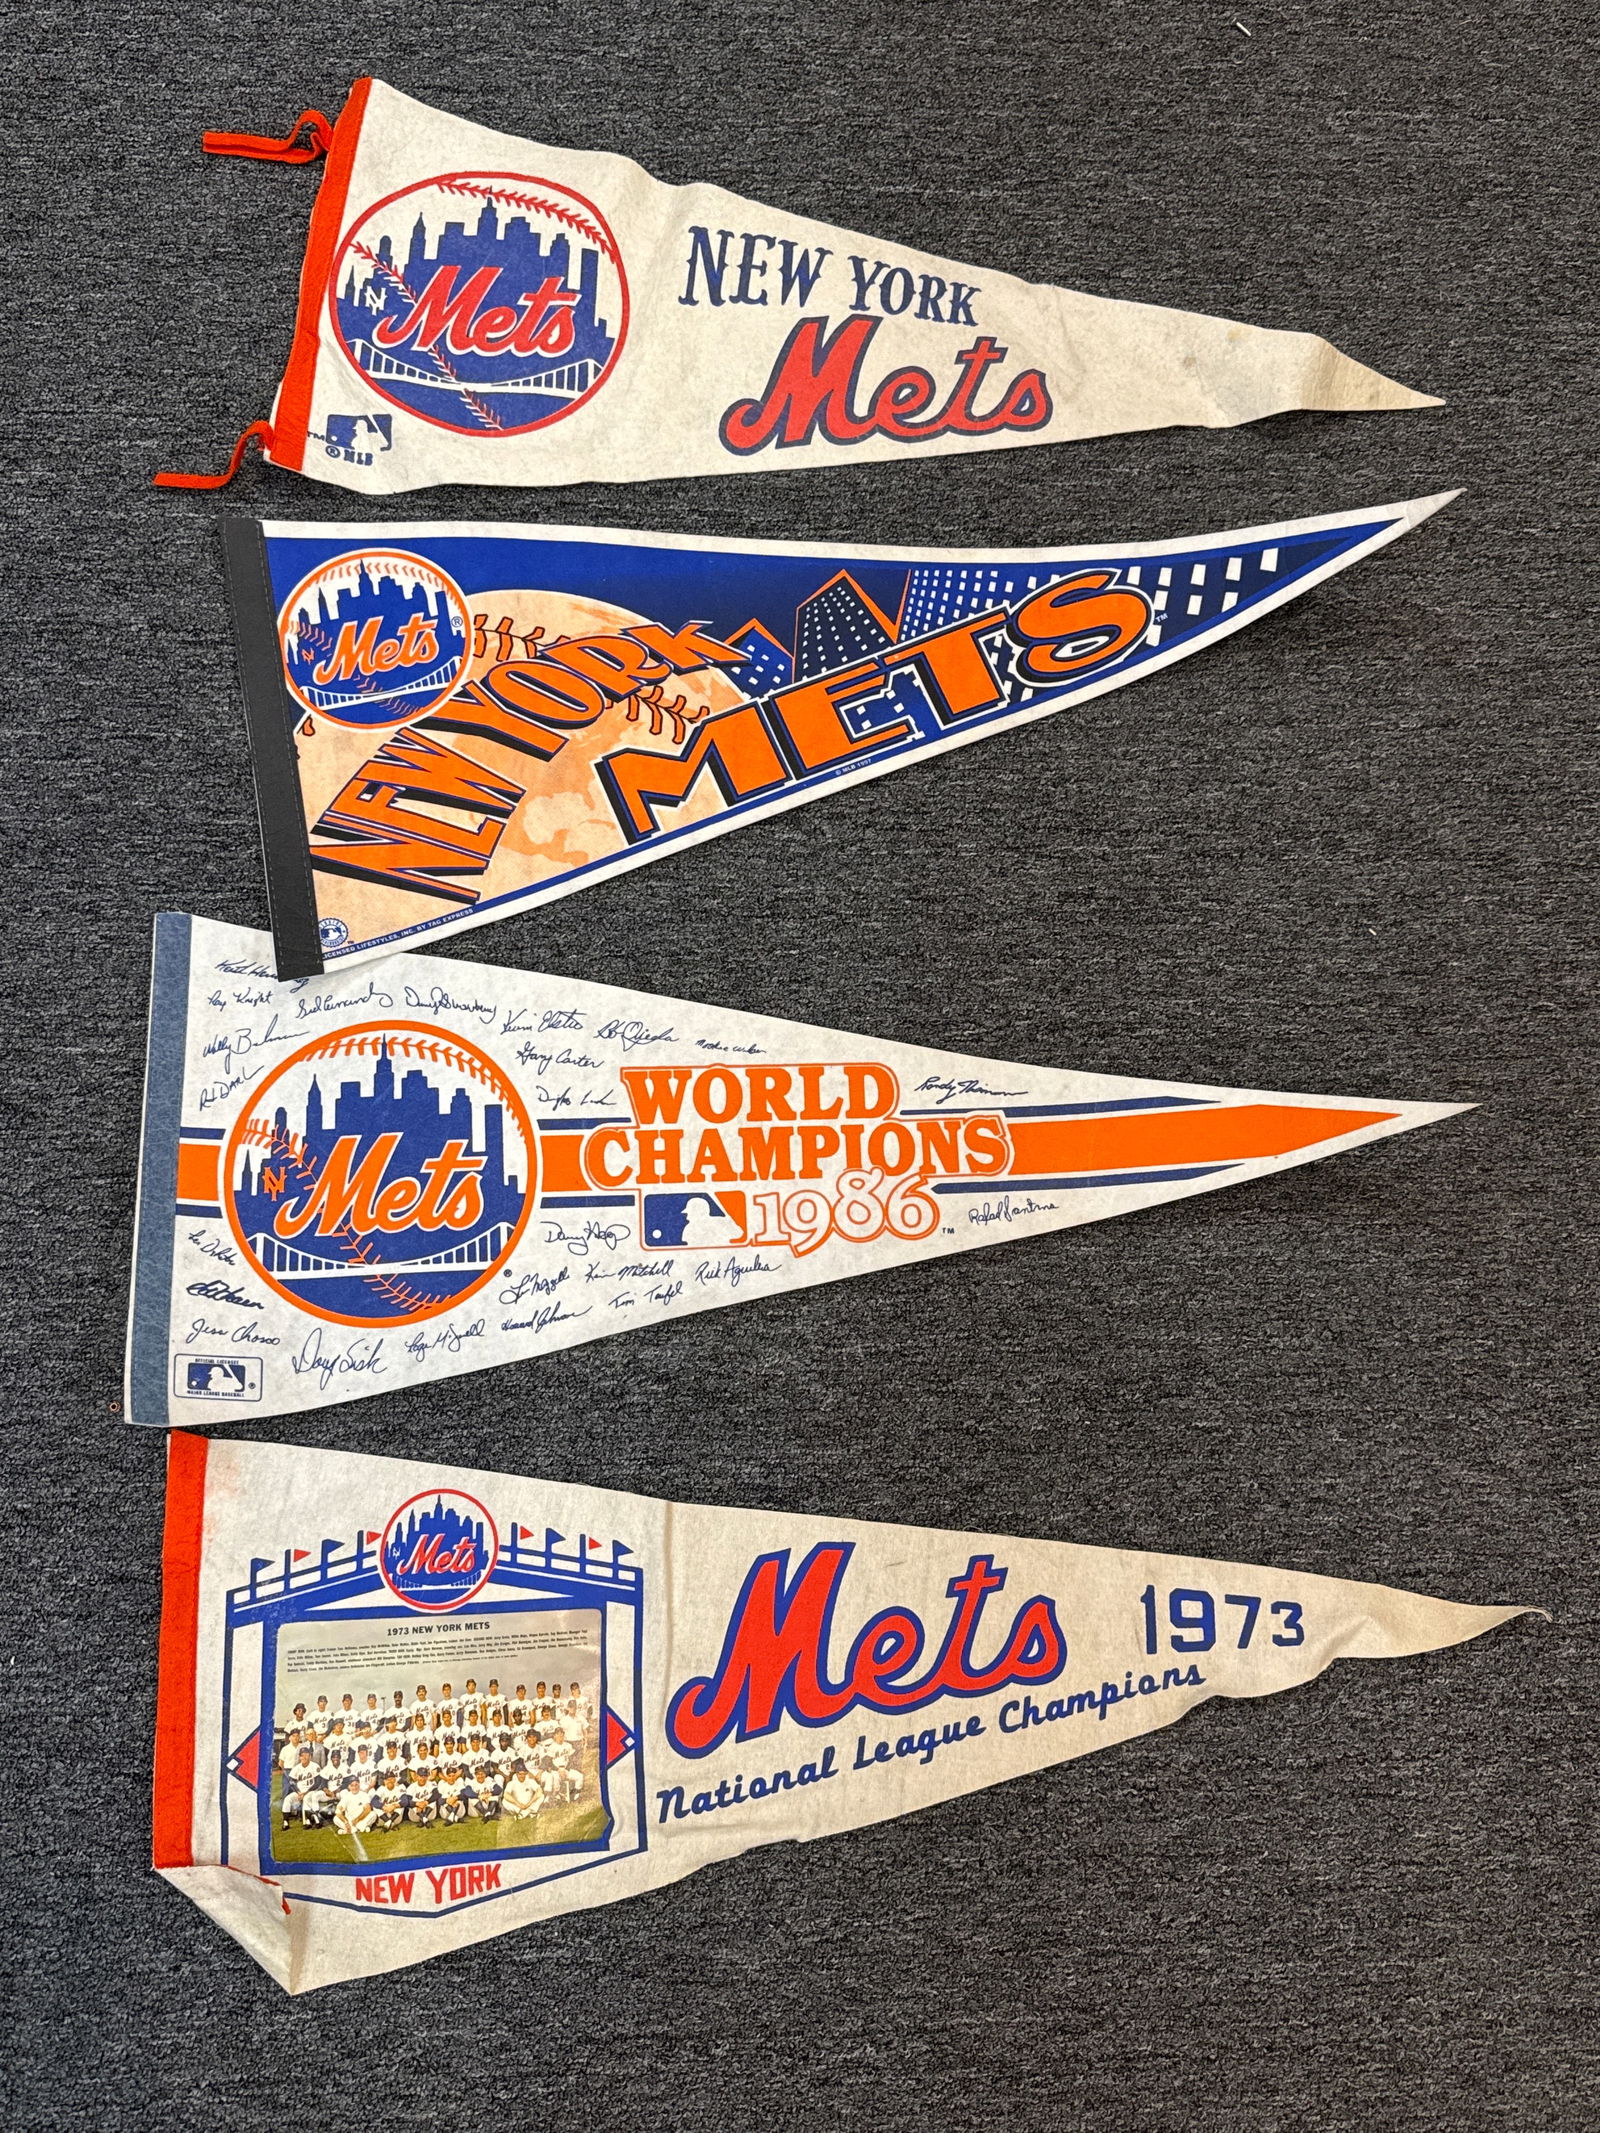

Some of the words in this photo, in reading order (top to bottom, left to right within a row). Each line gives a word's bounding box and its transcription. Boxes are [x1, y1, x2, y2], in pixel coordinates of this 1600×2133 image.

[374, 265, 583, 357] Mets
[678, 226, 833, 307] NEW
[847, 255, 982, 327] YORK
[718, 314, 1054, 457] Mets
[344, 449, 373, 466] MLB
[313, 612, 440, 686] Mets
[413, 620, 753, 762] YORK
[595, 566, 1155, 846] METS
[309, 729, 527, 905] NEW
[417, 923, 427, 932] BY
[428, 919, 442, 929] TAG
[443, 908, 474, 923] EXPRESS
[624, 1066, 897, 1126] WORLD
[273, 1132, 489, 1239] Mets
[587, 1117, 1009, 1187] CHAMPIONS
[750, 1167, 941, 1258] 1986
[396, 1533, 477, 1575] Mets
[387, 1628, 409, 1636] 1973
[412, 1625, 434, 1634] NEW
[437, 1623, 462, 1632] YORK
[465, 1621, 490, 1630] METS
[665, 1541, 1067, 1759] Mets
[1140, 1584, 1305, 1655] 1973
[656, 1744, 838, 1823] National
[853, 1713, 987, 1771] League
[998, 1664, 1206, 1733] Champions
[355, 1871, 415, 1904] NEW
[425, 1863, 502, 1905] YORK
